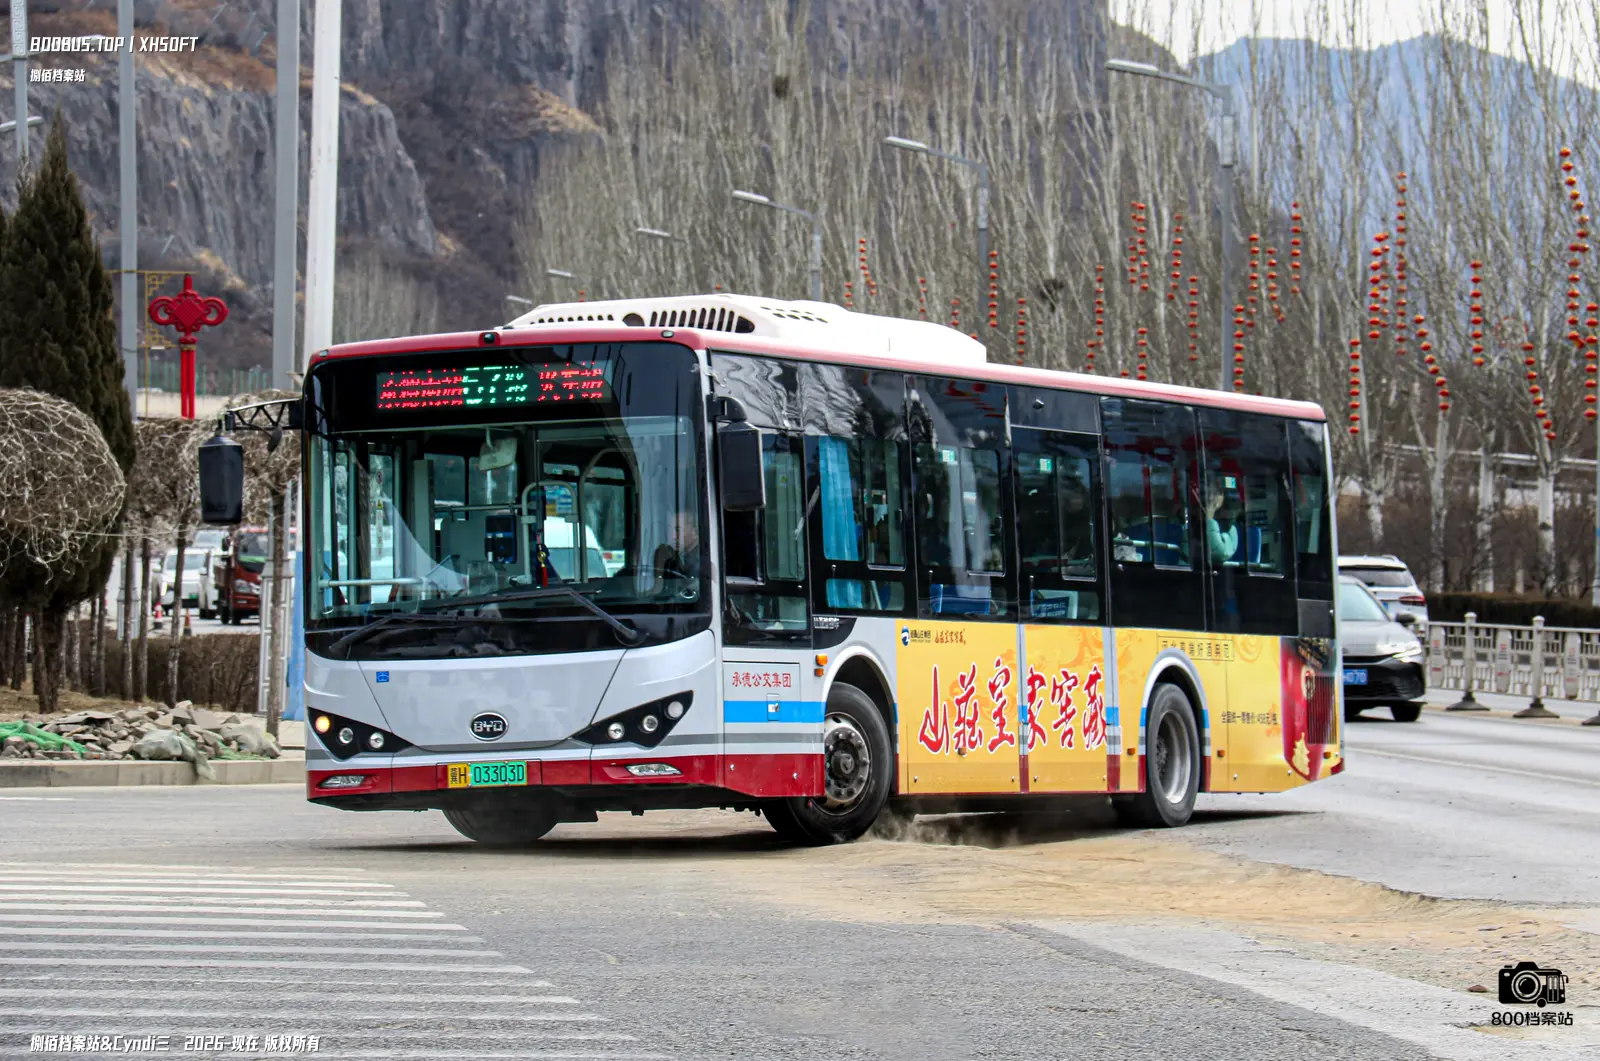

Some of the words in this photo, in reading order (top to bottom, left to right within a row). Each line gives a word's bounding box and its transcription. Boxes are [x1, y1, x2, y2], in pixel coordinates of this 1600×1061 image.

[732, 671, 792, 688] 承德公交集团
[473, 720, 503, 732] BYD
